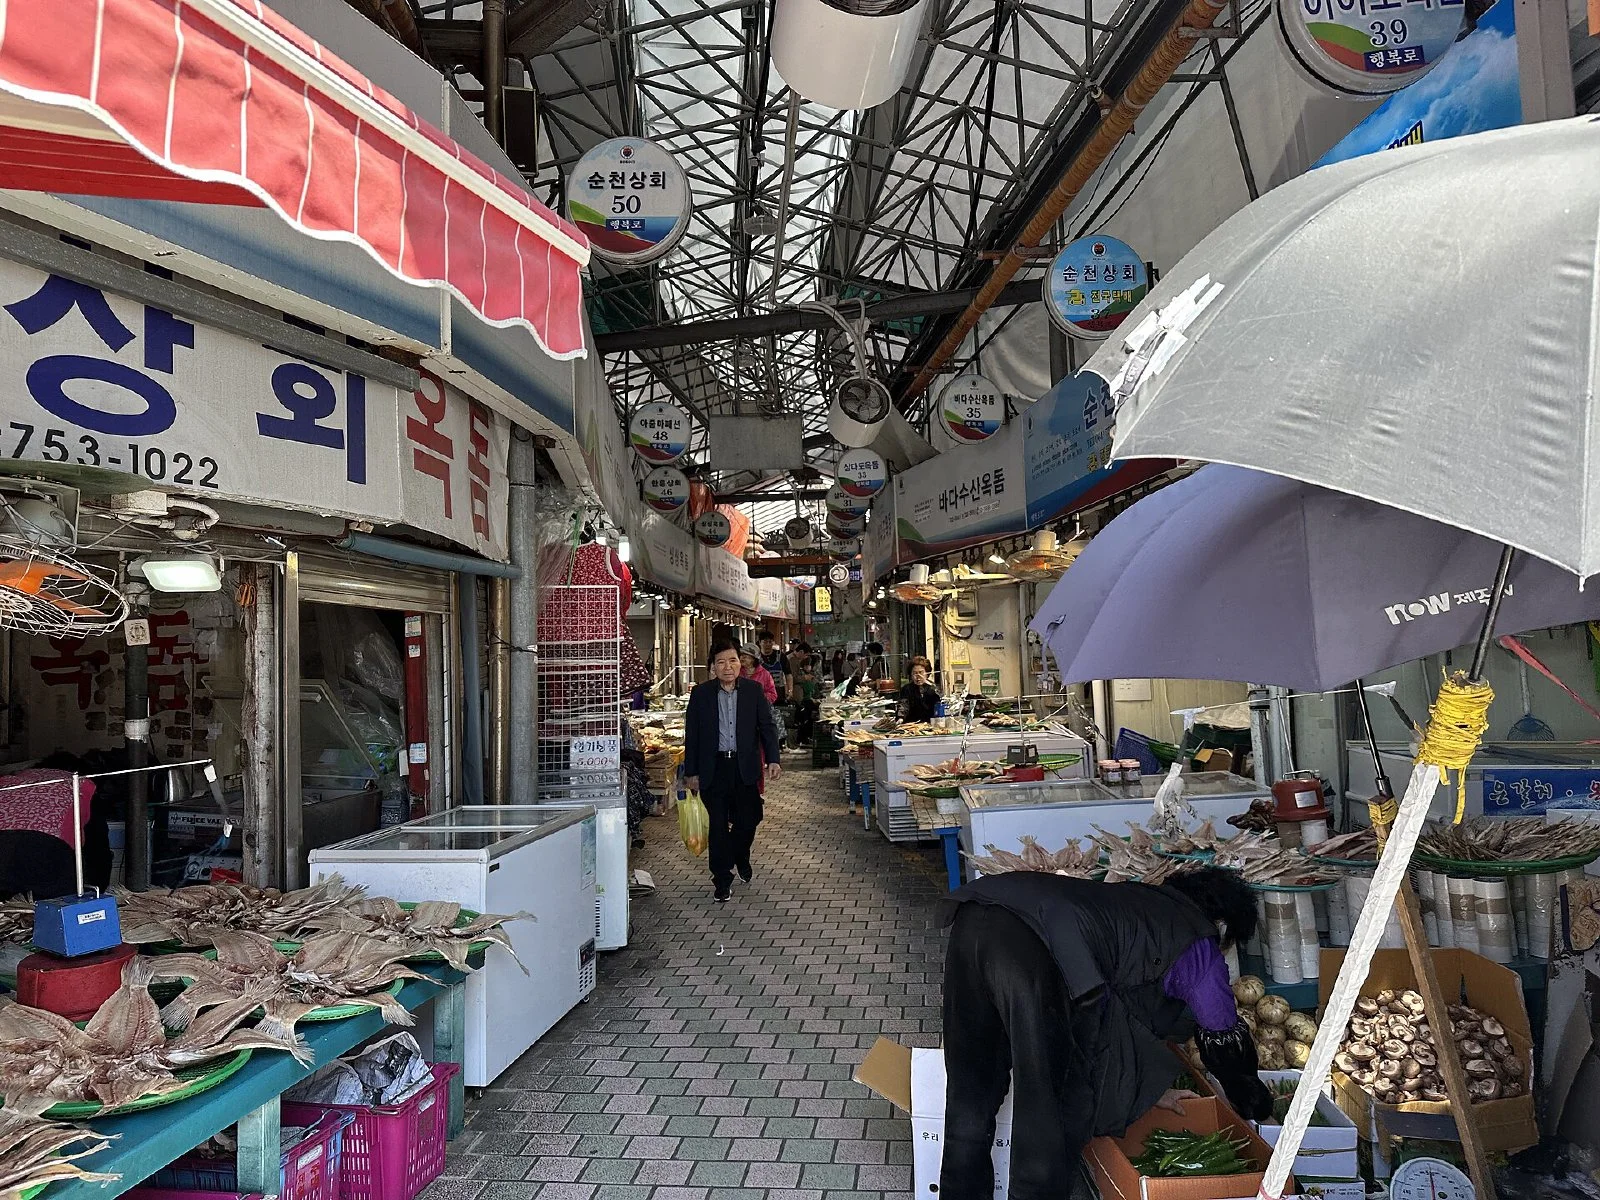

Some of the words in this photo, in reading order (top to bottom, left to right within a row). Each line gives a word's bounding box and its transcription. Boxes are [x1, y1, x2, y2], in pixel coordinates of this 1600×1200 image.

[1369, 18, 1408, 48] 39
[1368, 48, 1420, 68] 행복로
[587, 171, 667, 190] 순천상회
[611, 195, 641, 214] 50
[1062, 263, 1137, 284] 순천상회
[1090, 289, 1133, 304] 전국택배
[953, 393, 995, 406] 바다수산옥돔
[966, 407, 981, 419] 35
[653, 431, 669, 441] 48
[857, 471, 867, 479] 33
[938, 467, 1005, 513] 바다수산옥돔
[843, 499, 853, 507] 31
[1488, 778, 1553, 809] 은갈치
[922, 1131, 939, 1142] 우리
